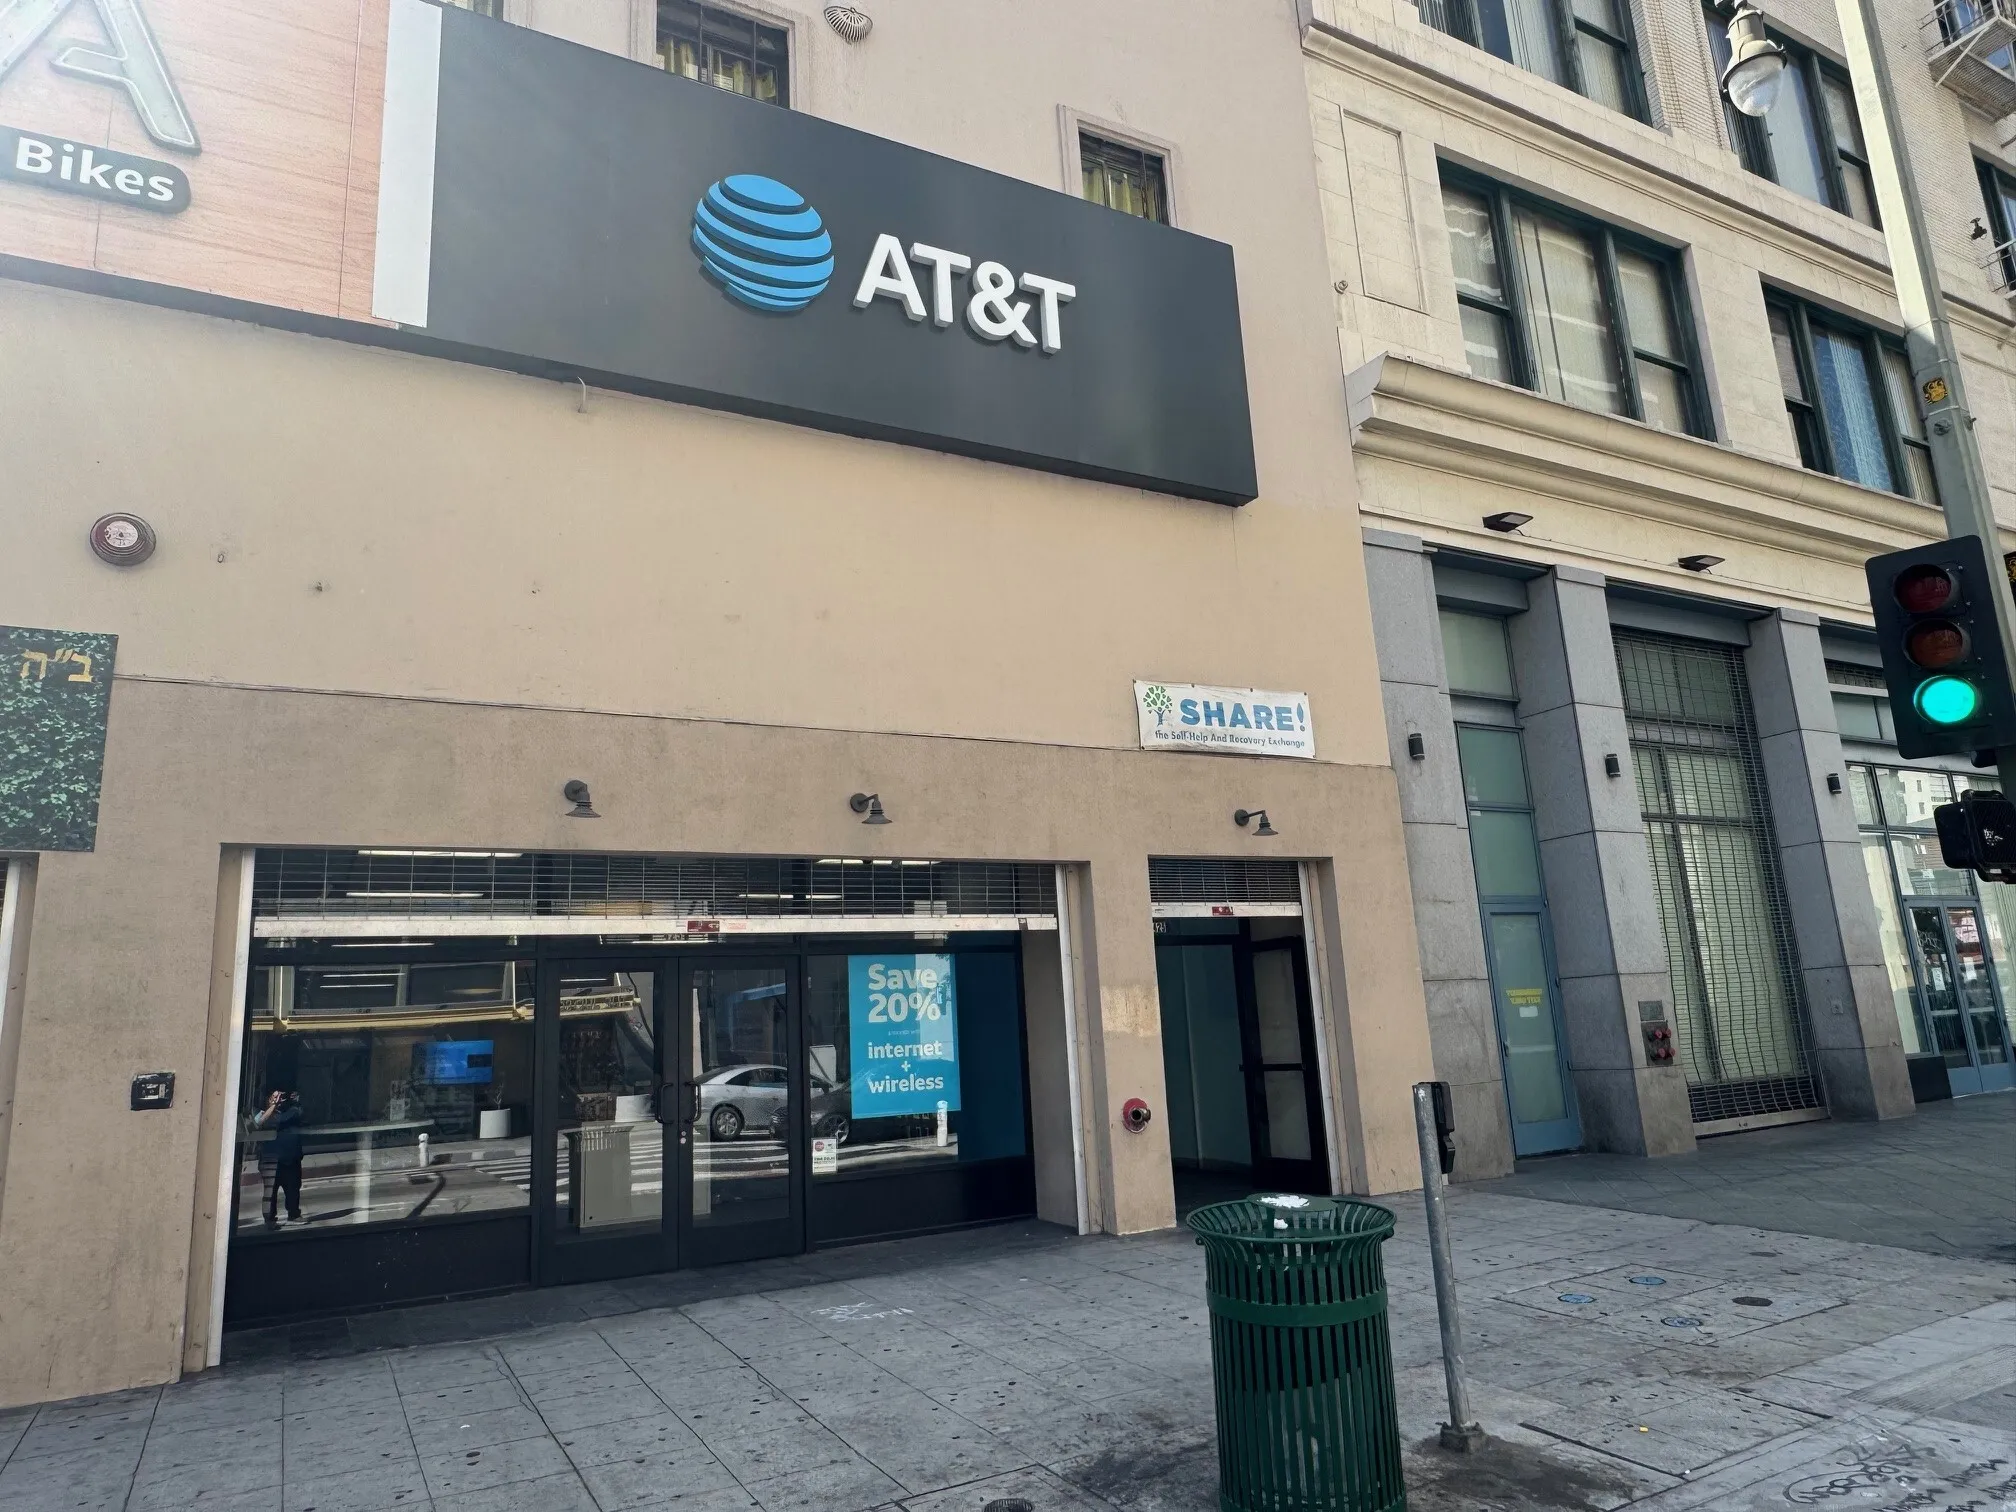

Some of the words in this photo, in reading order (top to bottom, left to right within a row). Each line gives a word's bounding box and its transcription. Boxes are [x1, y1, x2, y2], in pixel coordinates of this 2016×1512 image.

[15, 137, 174, 202] Bikes
[852, 233, 1077, 355] AT&T
[1180, 698, 1306, 732] SHARE!
[1155, 730, 1169, 740] the
[1211, 734, 1227, 742] And
[1229, 734, 1266, 746] Recovery
[1268, 737, 1305, 748] Exchange
[868, 963, 938, 991] Save
[868, 992, 941, 1023] 20%
[867, 1041, 943, 1059] internet
[867, 1073, 944, 1094] wireless
